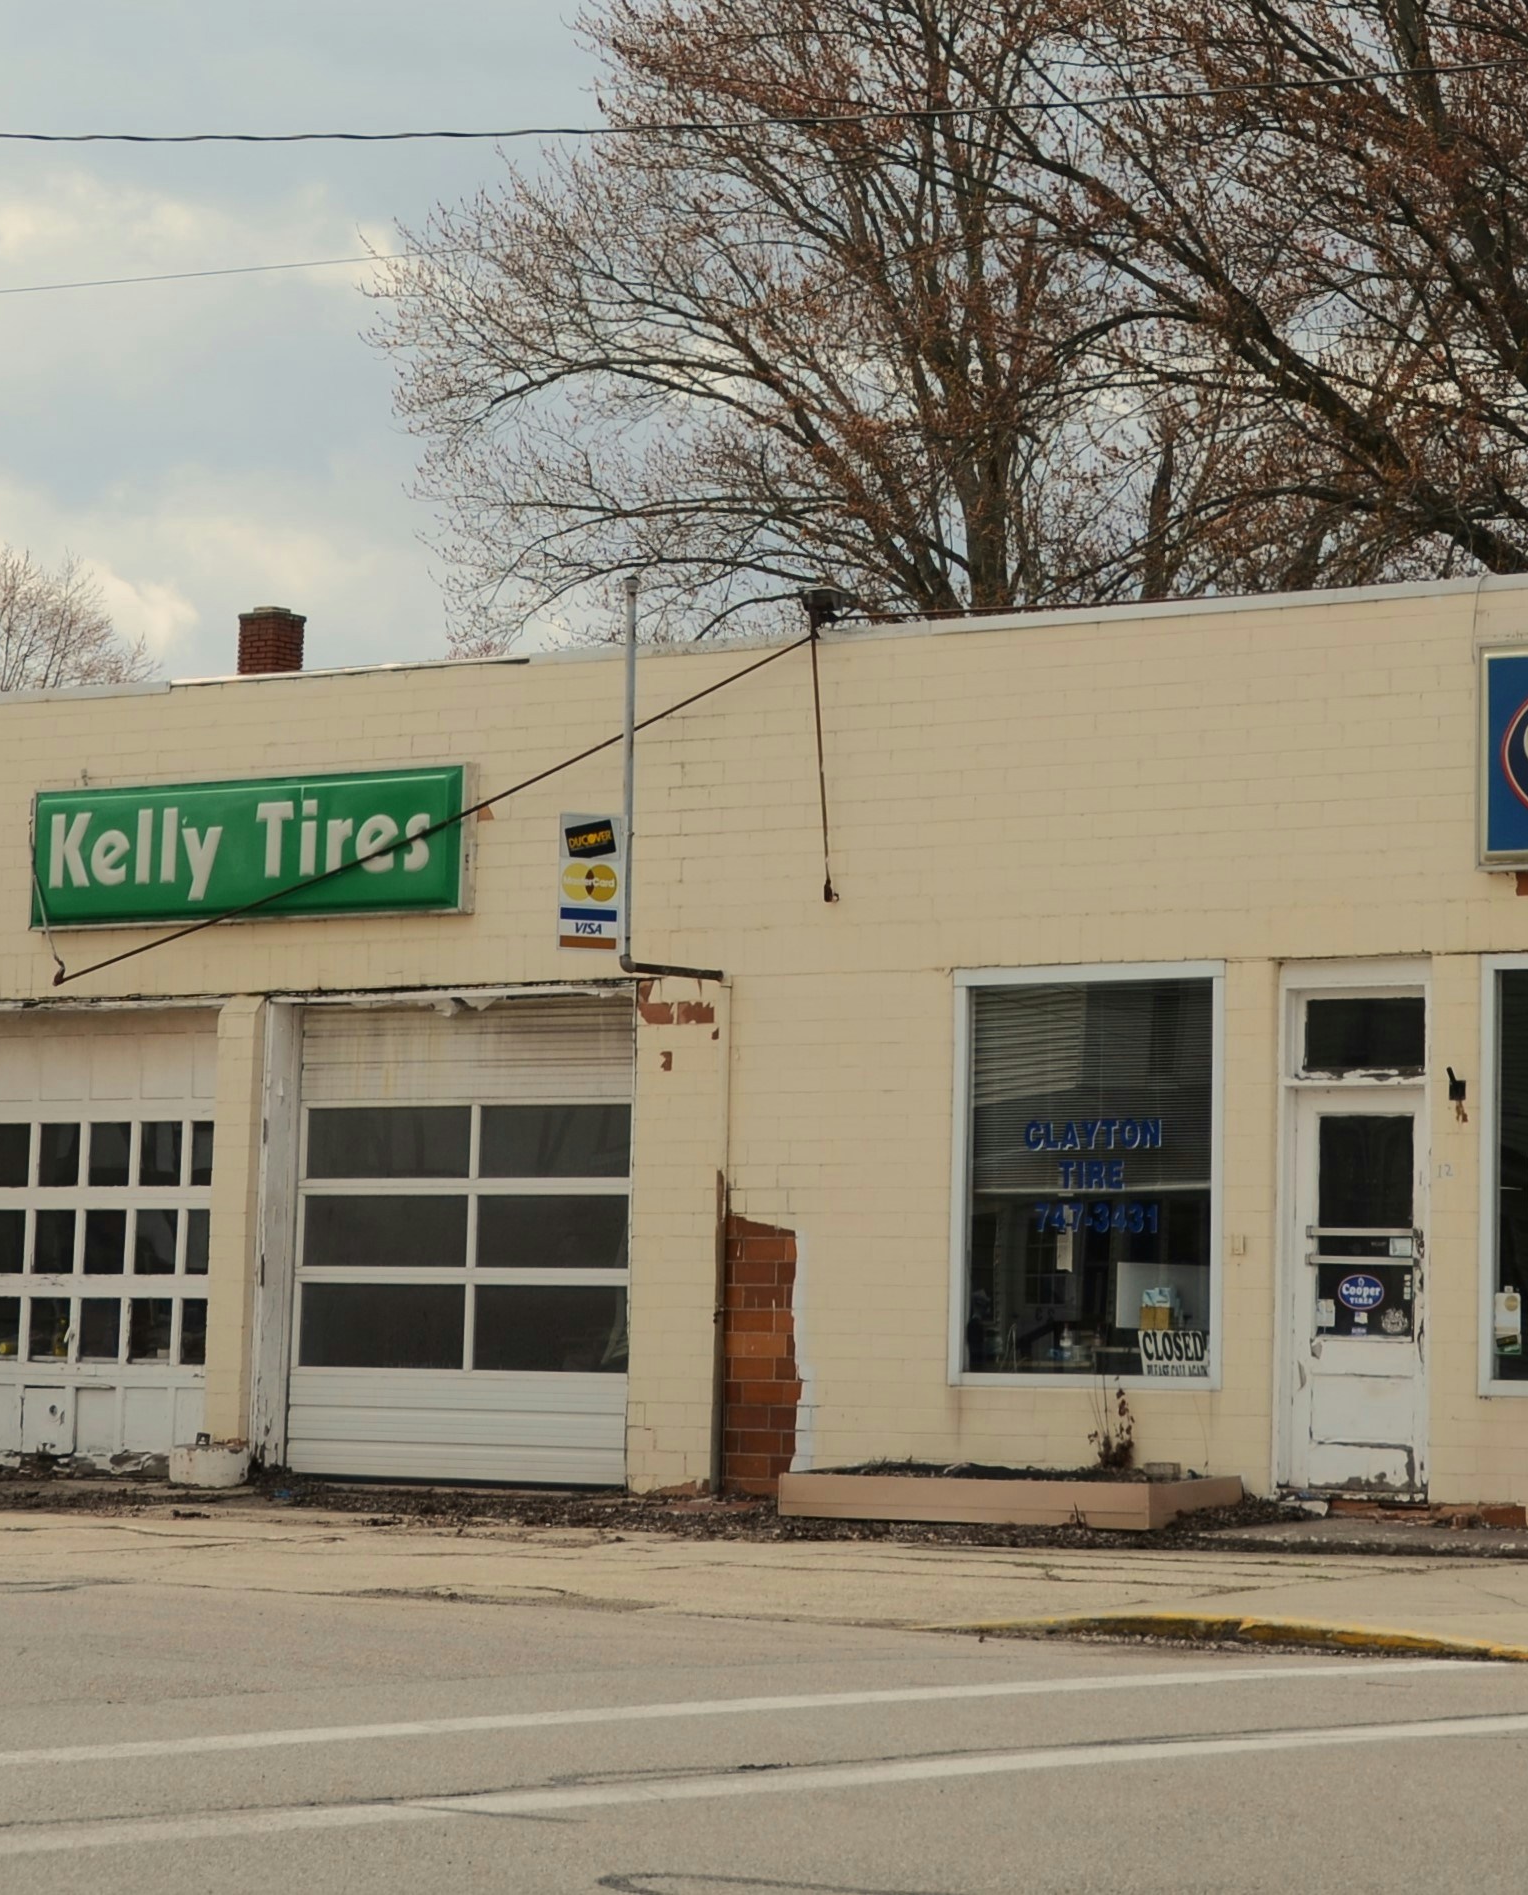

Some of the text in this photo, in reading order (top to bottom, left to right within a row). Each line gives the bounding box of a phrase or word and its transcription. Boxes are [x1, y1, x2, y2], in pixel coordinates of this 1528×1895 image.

[49, 799, 432, 902] Kelly Tires
[563, 875, 615, 888] MasterCard
[575, 922, 602, 935] VISA
[1025, 1119, 1163, 1151] CLAYTON
[1059, 1160, 1126, 1191] TIRE
[1036, 1203, 1158, 1234] 747-3431
[1342, 1284, 1381, 1297] Cooper
[1143, 1331, 1204, 1361] CLOSED
